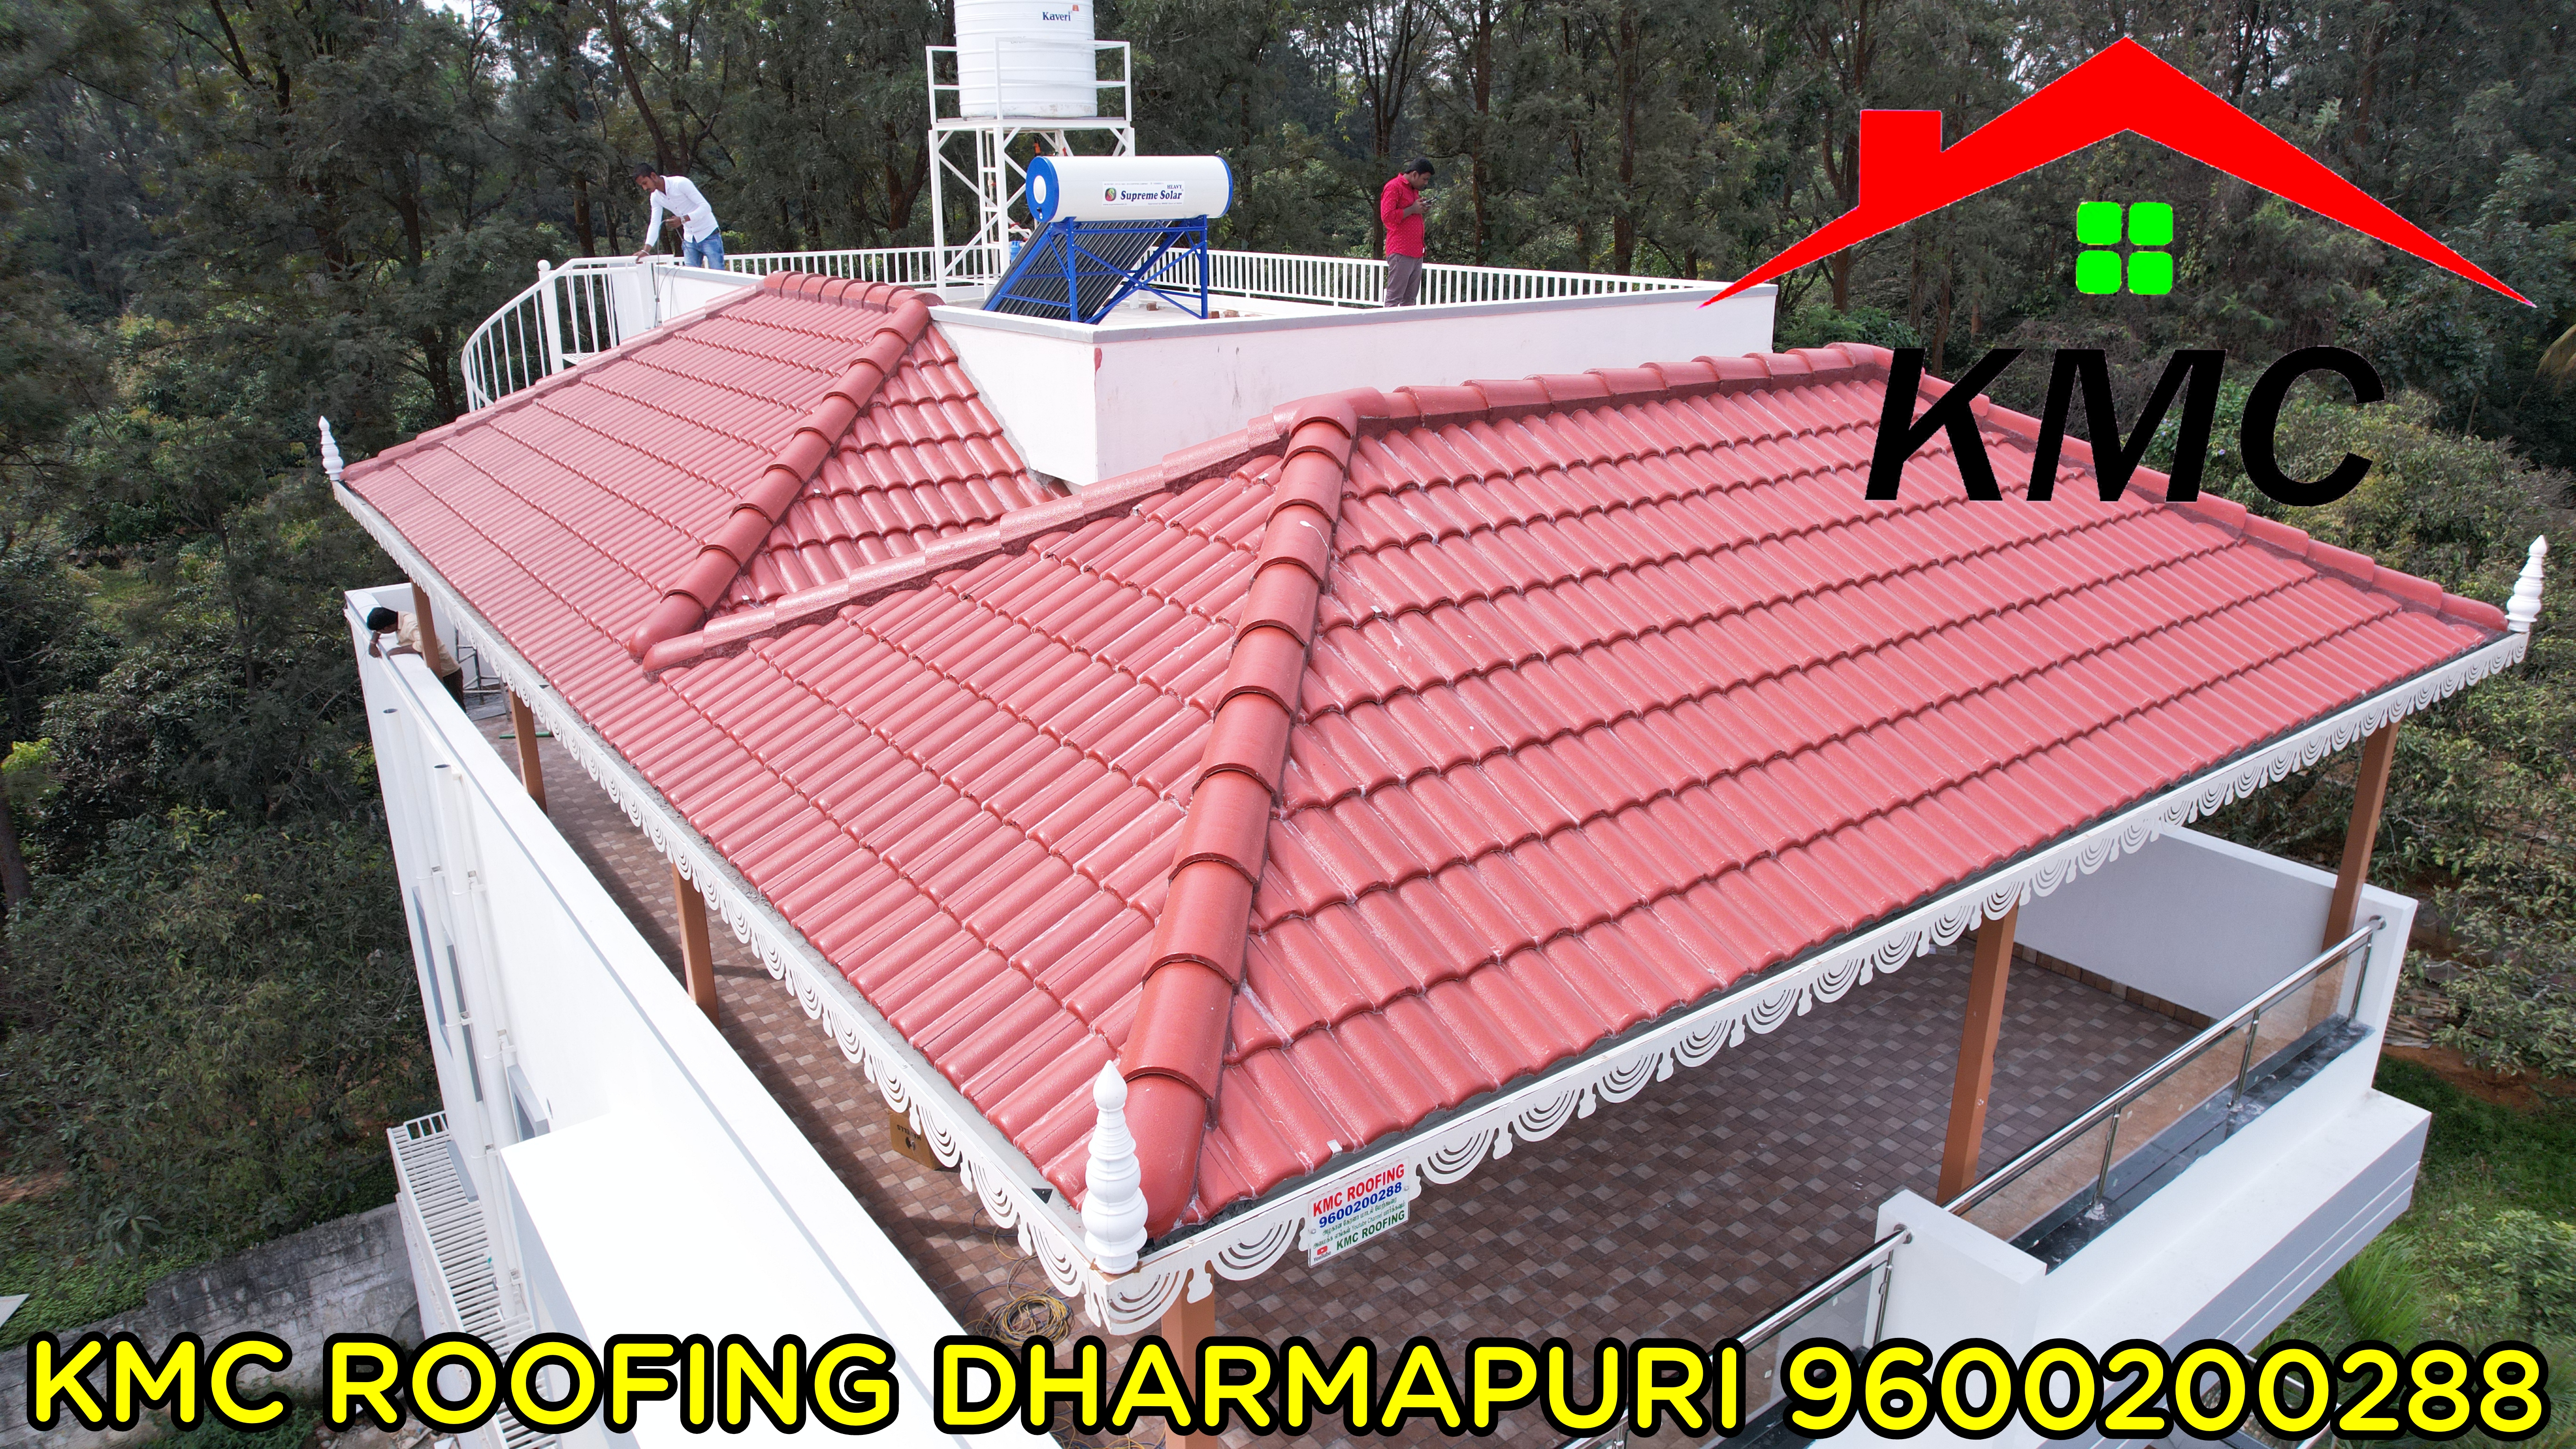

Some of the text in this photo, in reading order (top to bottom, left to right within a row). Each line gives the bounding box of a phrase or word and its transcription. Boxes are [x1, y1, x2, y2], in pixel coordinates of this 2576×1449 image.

[1042, 10, 1071, 21] Kaveri
[1120, 190, 1182, 202] Supreme Solar
[897, 1124, 921, 1141] HAELLS
[1313, 1164, 1404, 1217] KMC ROOFING
[1319, 1182, 1402, 1228] 9600200288
[1352, 1220, 1367, 1231] Youtube
[1368, 1211, 1383, 1223] Channel
[1336, 1210, 1405, 1251] KMC ROOFING
[1313, 1251, 1331, 1262] YouTube
